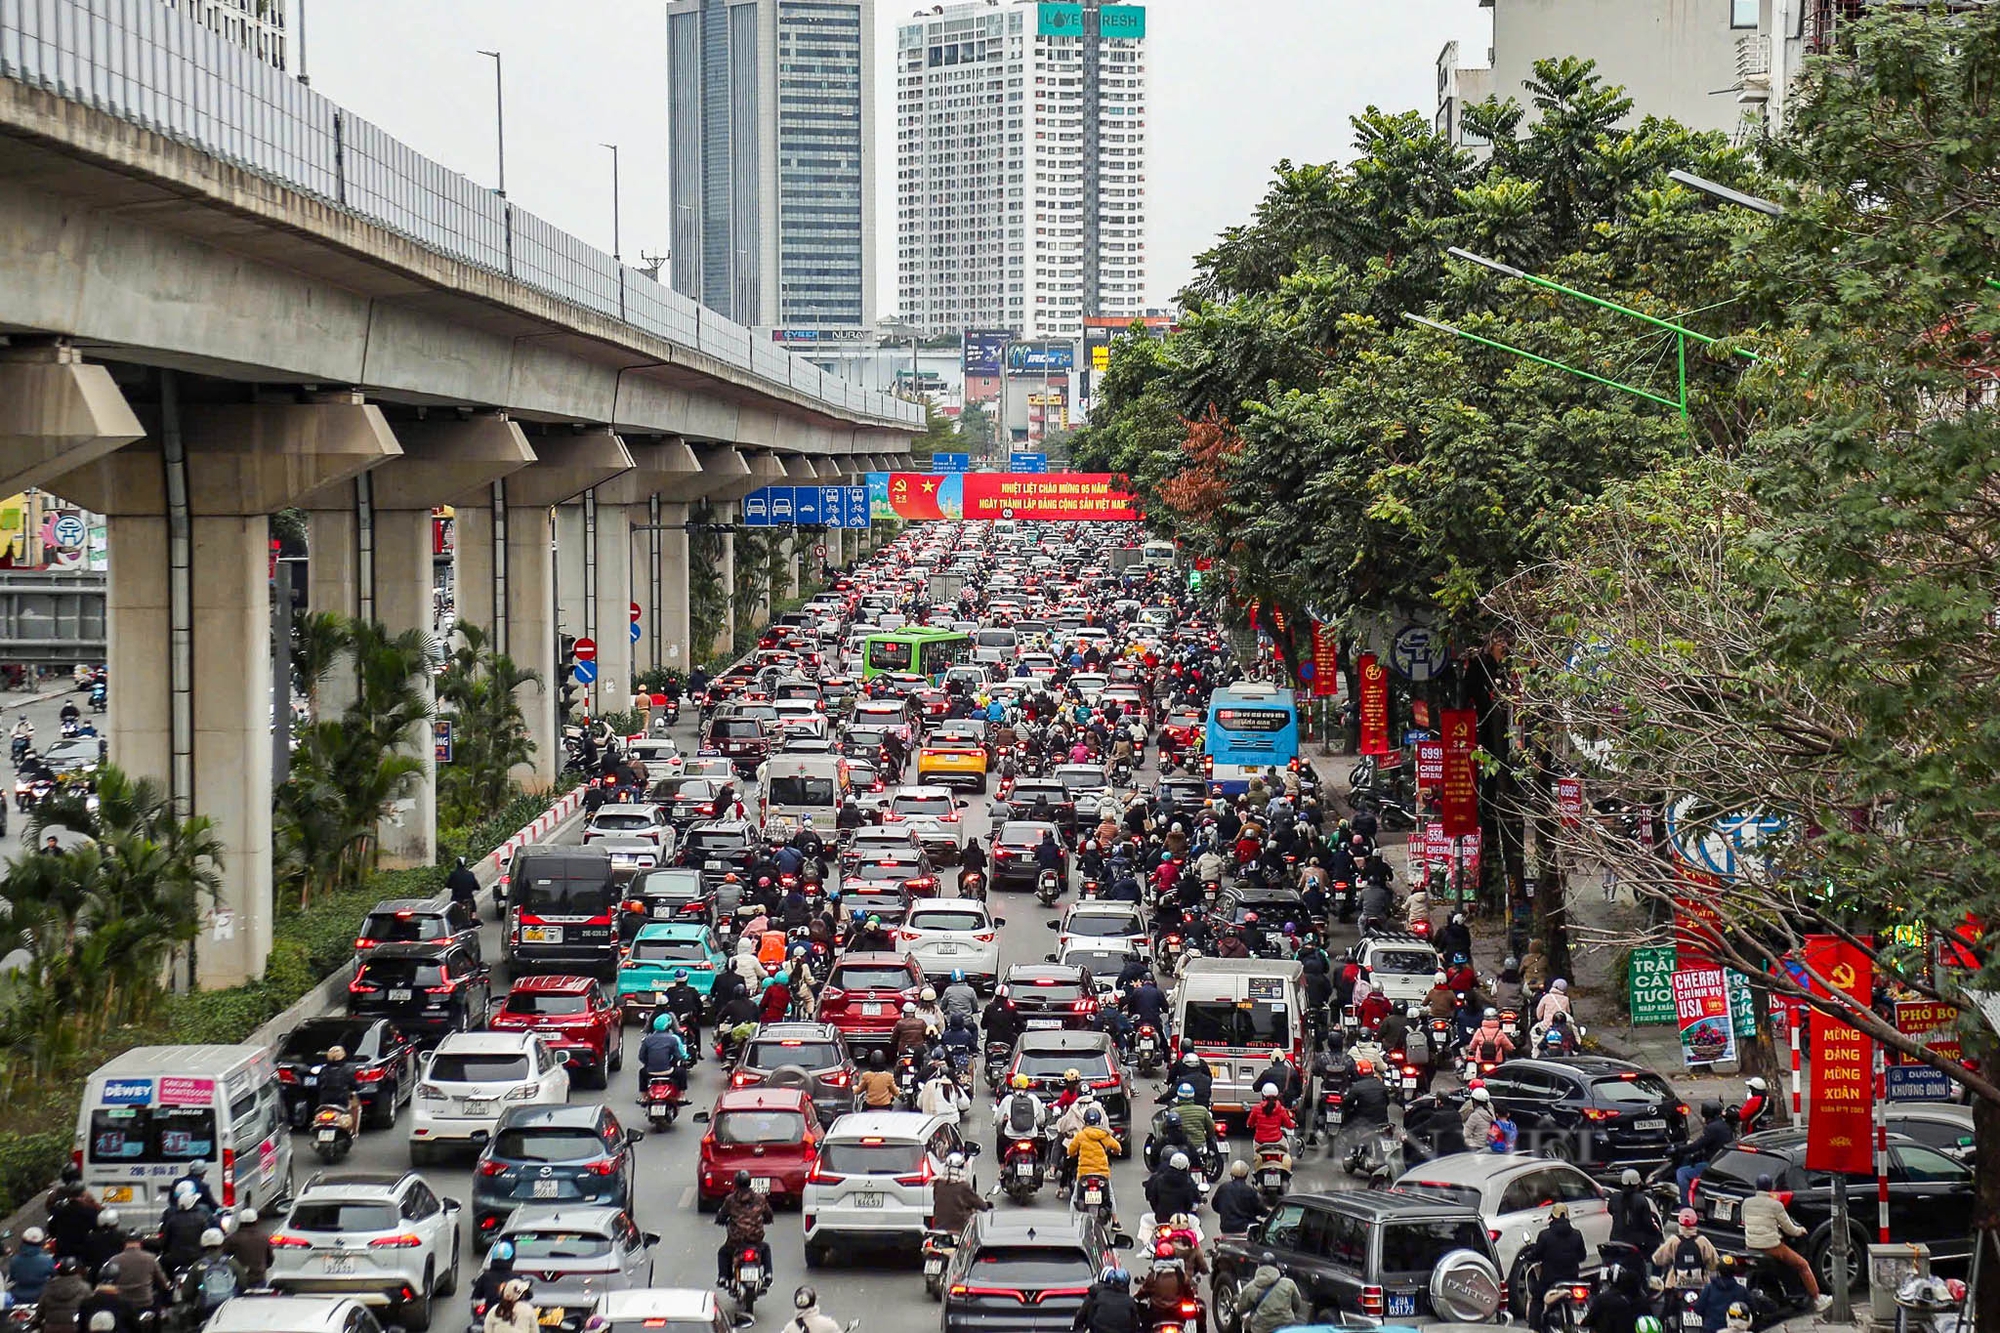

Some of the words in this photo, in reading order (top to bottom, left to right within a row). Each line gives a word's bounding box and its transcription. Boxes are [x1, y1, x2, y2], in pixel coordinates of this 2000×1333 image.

[1002, 481, 1021, 495] NHIỆT
[1023, 481, 1037, 495] LIỆT
[1039, 481, 1057, 493] CHÀO
[1081, 483, 1090, 493] 95
[979, 497, 997, 509] NGÀY
[1000, 497, 1022, 509] THÀNH
[1023, 497, 1037, 511] LẬP
[1038, 497, 1057, 509] ĐẢNG
[1059, 497, 1077, 511] CỘNG
[1095, 497, 1110, 511] VIỆT
[1633, 956, 1675, 972] TRÁI
[1675, 970, 1721, 989] CHERRY
[1677, 987, 1708, 1000] CHÍNH
[1679, 999, 1704, 1019] USA
[1900, 1005, 1932, 1021] PHỞ
[1823, 1026, 1860, 1041] MỪNG
[1824, 1045, 1860, 1061] ĐẢNG
[1824, 1065, 1861, 1080] MỪNG
[1824, 1085, 1860, 1100] XUÂN
[1892, 1083, 1924, 1096] KHƯƠNG
[1926, 1081, 1946, 1095] ĐÌNH
